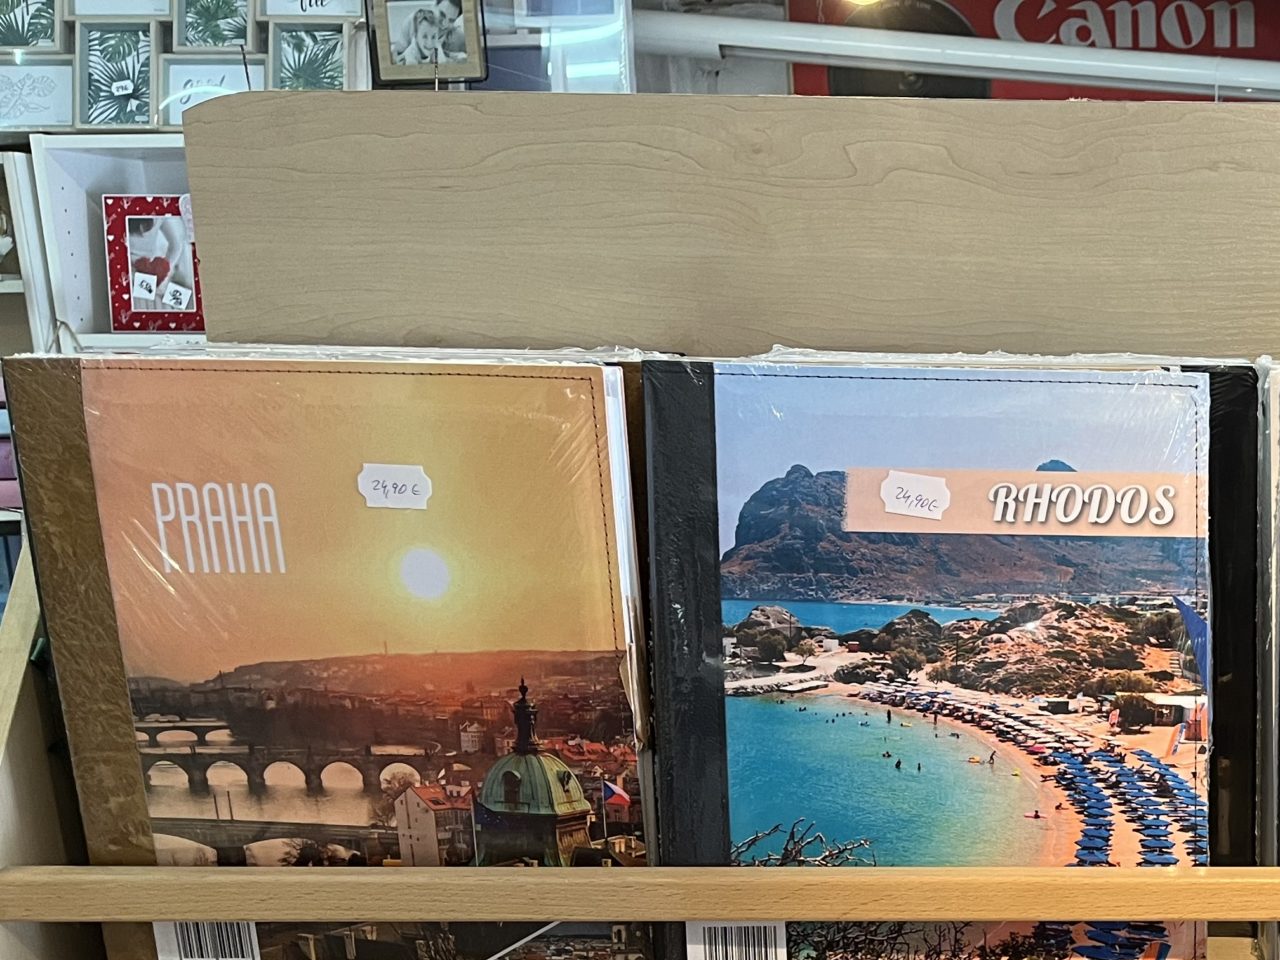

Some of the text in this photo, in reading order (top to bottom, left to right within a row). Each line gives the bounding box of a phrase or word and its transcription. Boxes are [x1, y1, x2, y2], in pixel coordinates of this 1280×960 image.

[993, 0, 1256, 49] Canon
[371, 479, 421, 498] 24,90 €
[895, 486, 939, 513] 24,90€
[988, 482, 1176, 526] RHODOS
[152, 482, 286, 574] PRAHA
